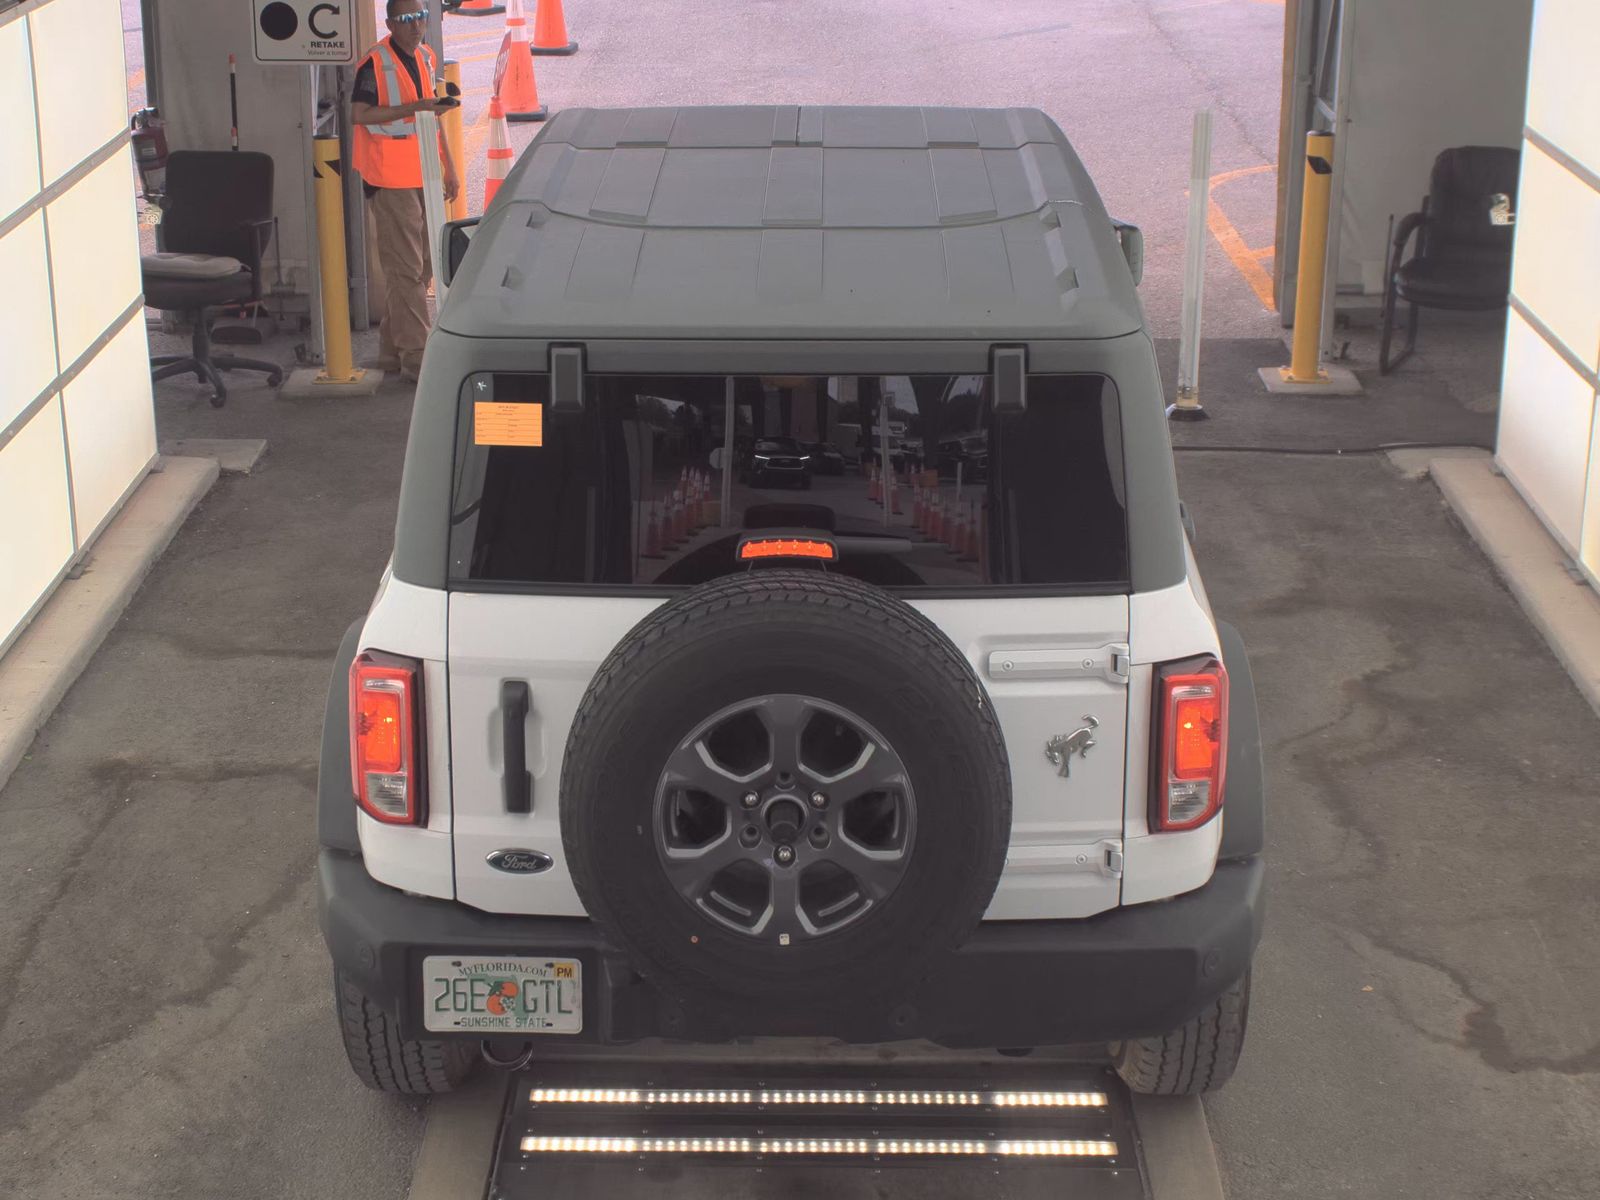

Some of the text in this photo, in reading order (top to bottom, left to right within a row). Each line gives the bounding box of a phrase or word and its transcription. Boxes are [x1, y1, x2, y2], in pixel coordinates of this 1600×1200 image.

[502, 855, 537, 869] Ford
[556, 967, 573, 978] PM
[434, 978, 573, 1014] 26E GTL
[461, 1016, 547, 1029] SUNSHINE STATE
